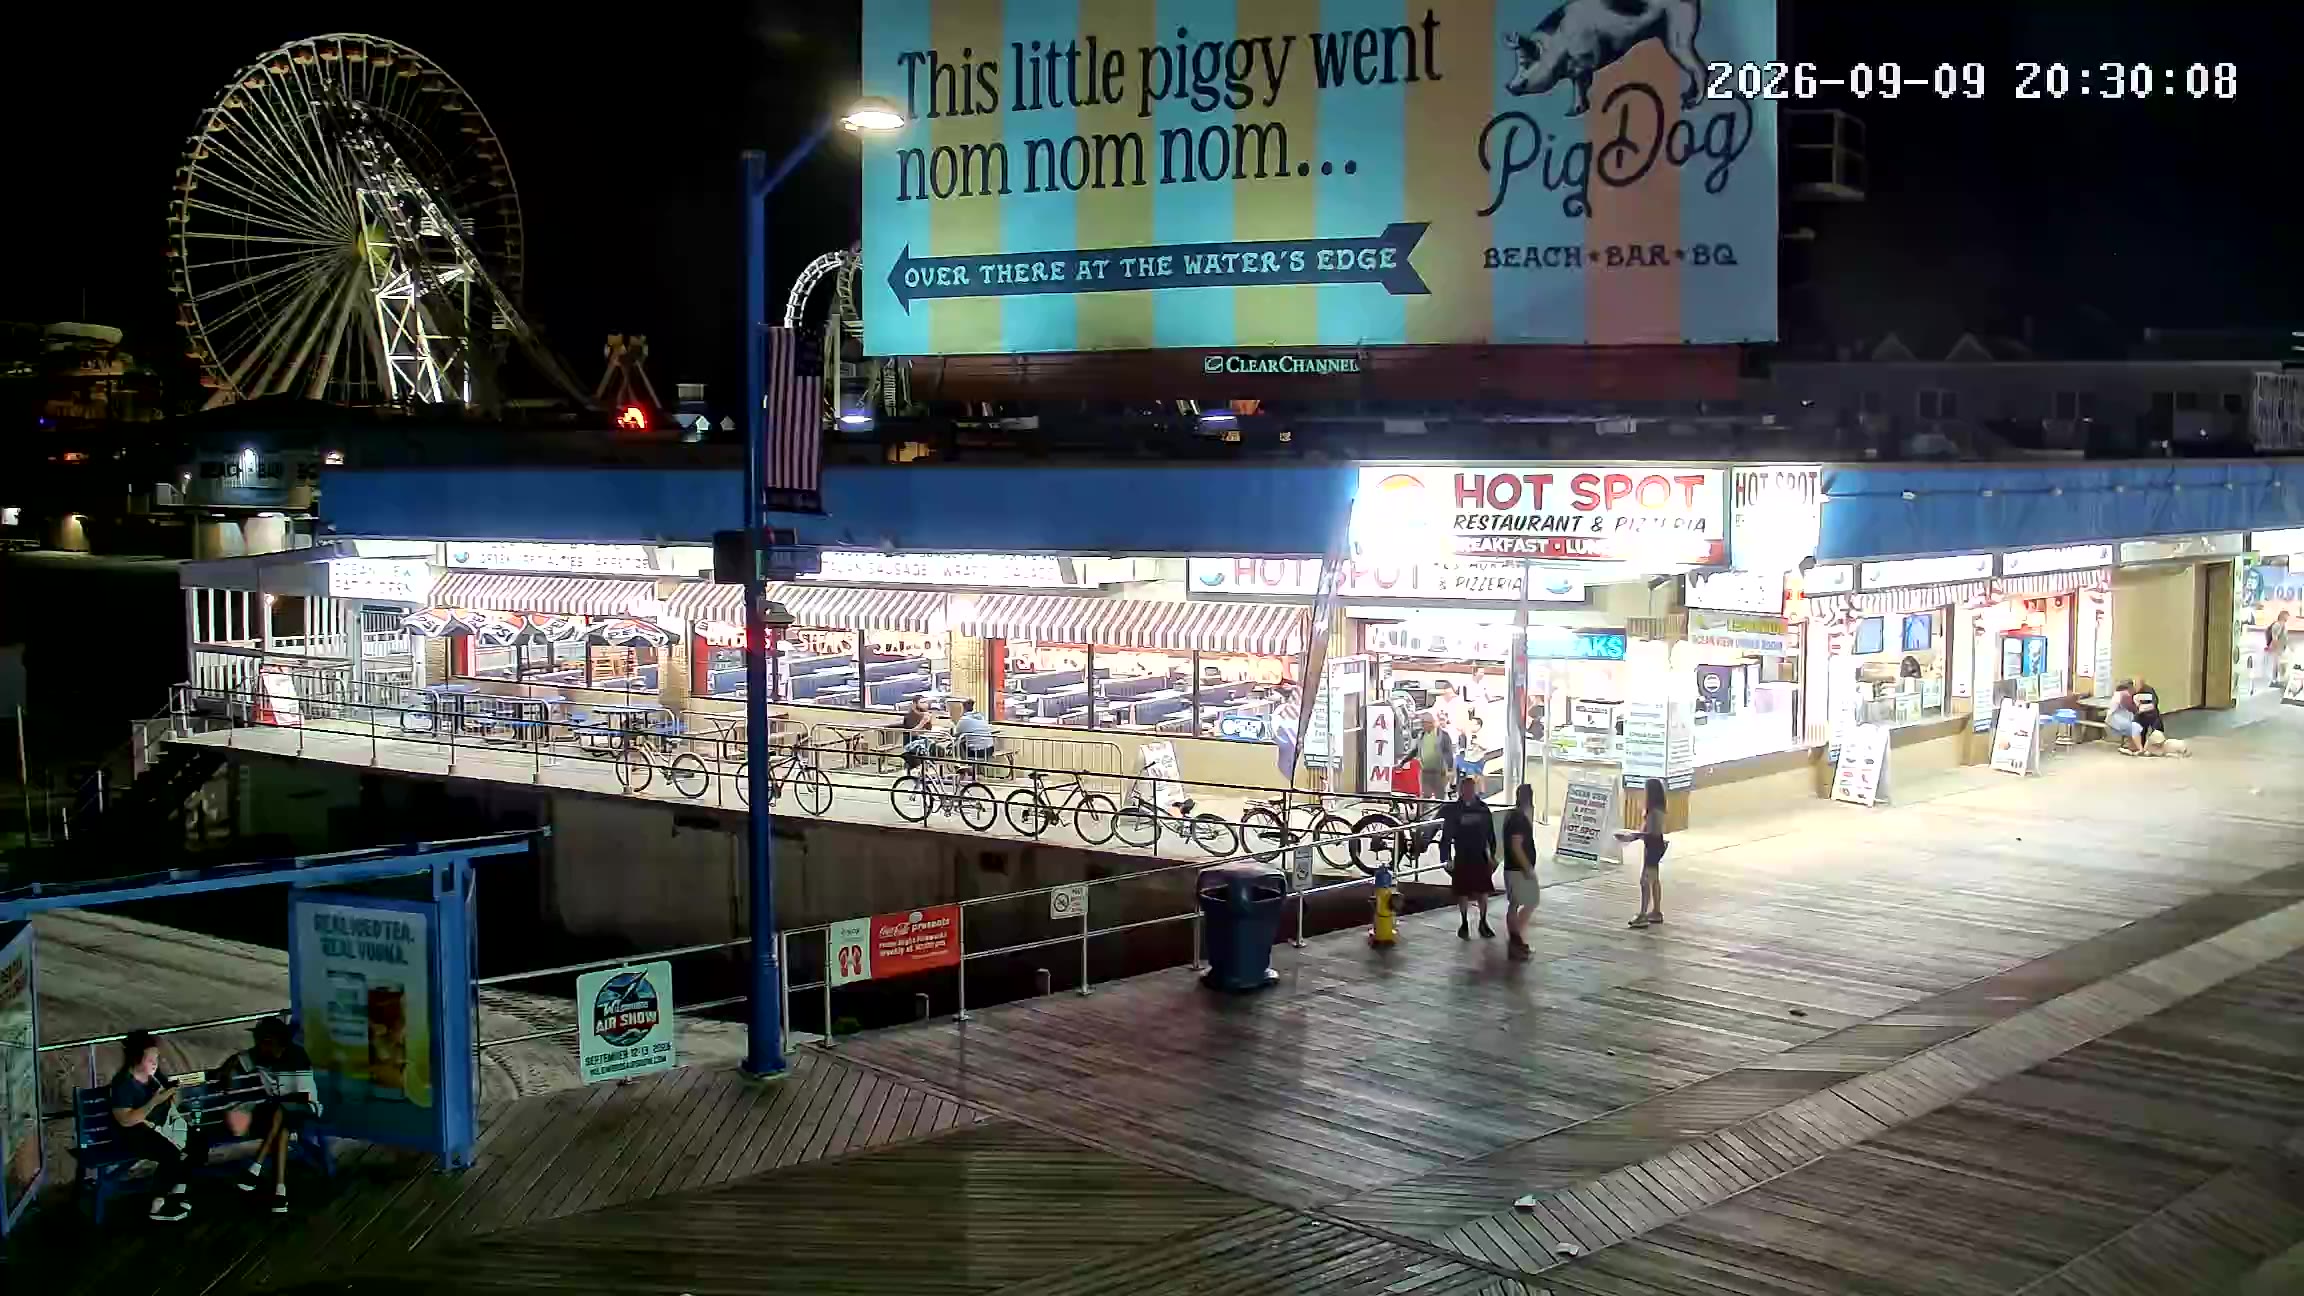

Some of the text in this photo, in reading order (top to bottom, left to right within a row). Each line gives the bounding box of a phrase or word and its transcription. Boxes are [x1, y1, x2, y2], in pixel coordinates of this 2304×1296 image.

[897, 9, 1443, 121] This little piggy went
[896, 120, 1358, 202] nom nom nom...
[904, 248, 1398, 289] OVER THERE AT THE WATER'S EDGE
[1483, 243, 1738, 269] BEACH BAR BQ
[1454, 473, 1705, 511] HOT SPOT
[1736, 472, 1769, 508] HOT
[1453, 514, 1583, 533] RESTAURANT
[1591, 517, 1603, 532] &
[1369, 713, 1390, 782] ATM
[595, 1010, 657, 1034] AIR SHOW
